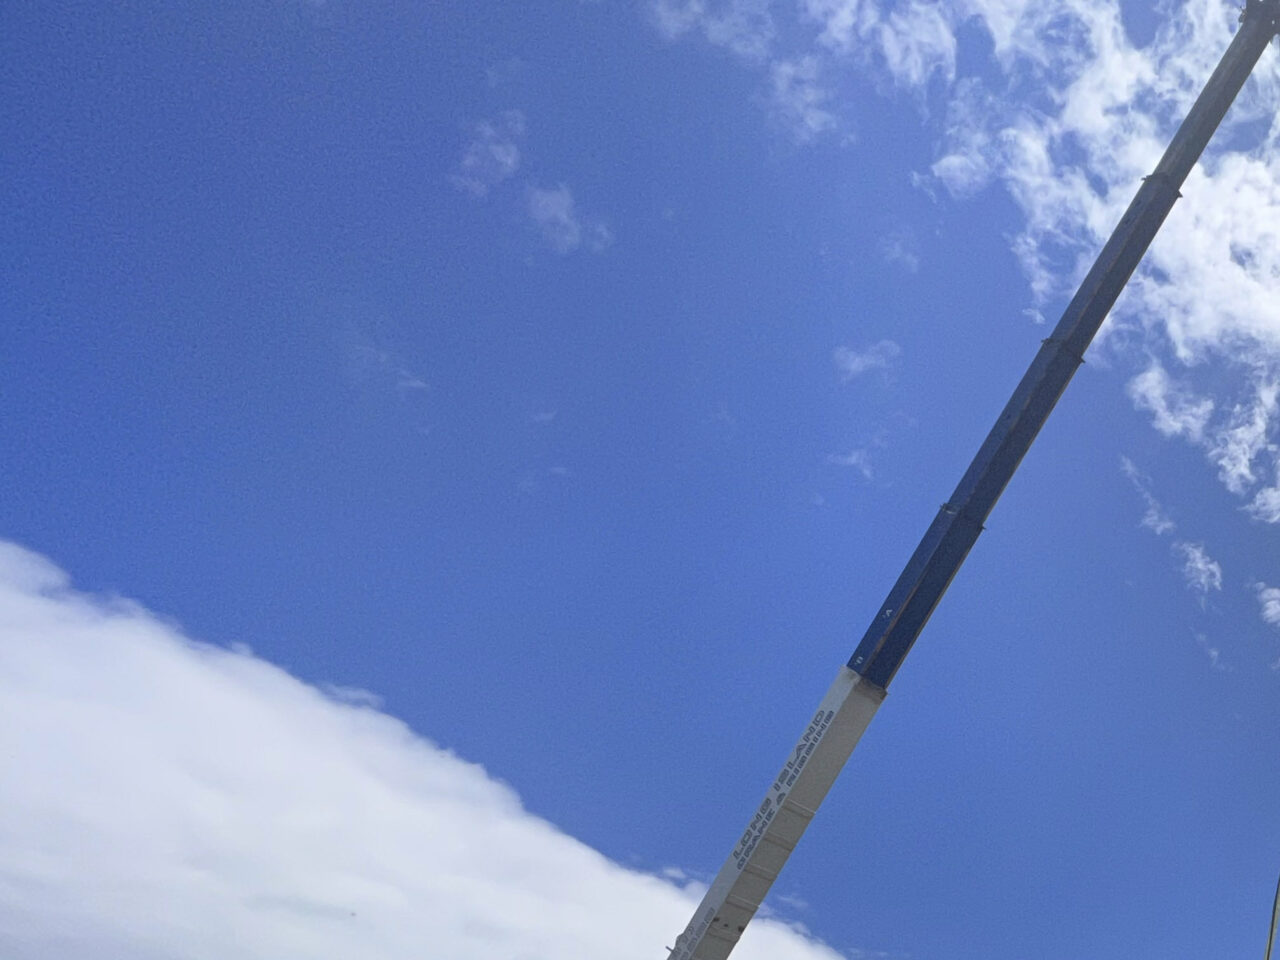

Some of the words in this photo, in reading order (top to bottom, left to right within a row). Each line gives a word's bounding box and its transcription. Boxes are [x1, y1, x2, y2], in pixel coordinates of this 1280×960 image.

[733, 798, 771, 859] LONG
[774, 710, 824, 791] ISLAND
[737, 810, 775, 870] CRANE
[786, 710, 834, 787] RIGGING
